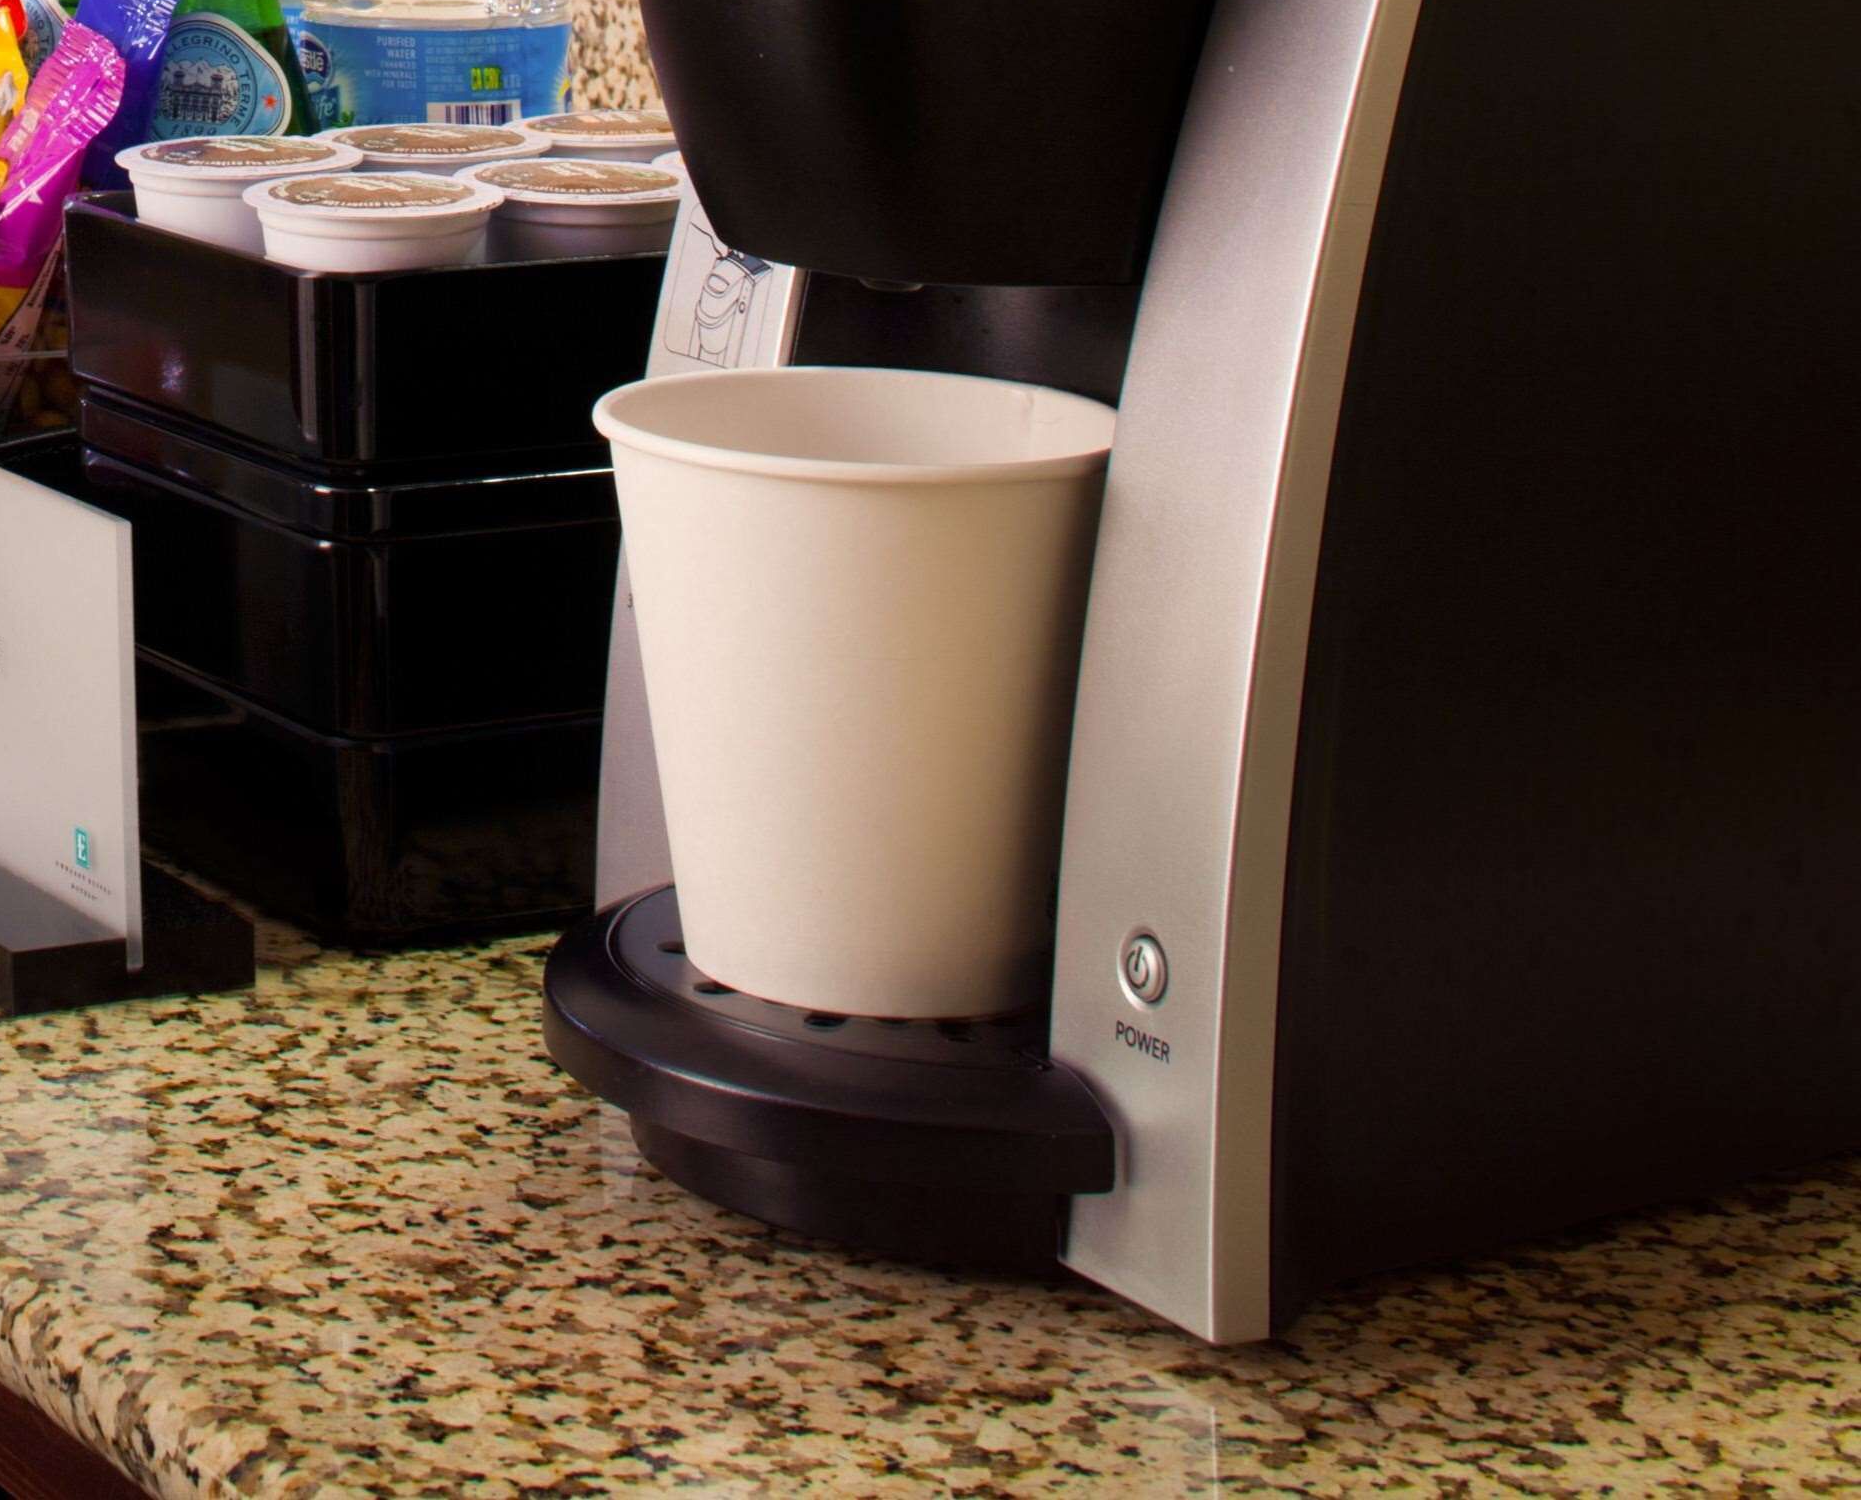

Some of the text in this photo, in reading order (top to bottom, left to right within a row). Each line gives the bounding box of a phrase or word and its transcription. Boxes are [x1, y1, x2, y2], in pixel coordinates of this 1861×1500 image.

[376, 36, 416, 47] PURIFIED
[387, 50, 416, 59] WATER
[230, 72, 252, 128] TERME
[1115, 1020, 1170, 1065] POWER
